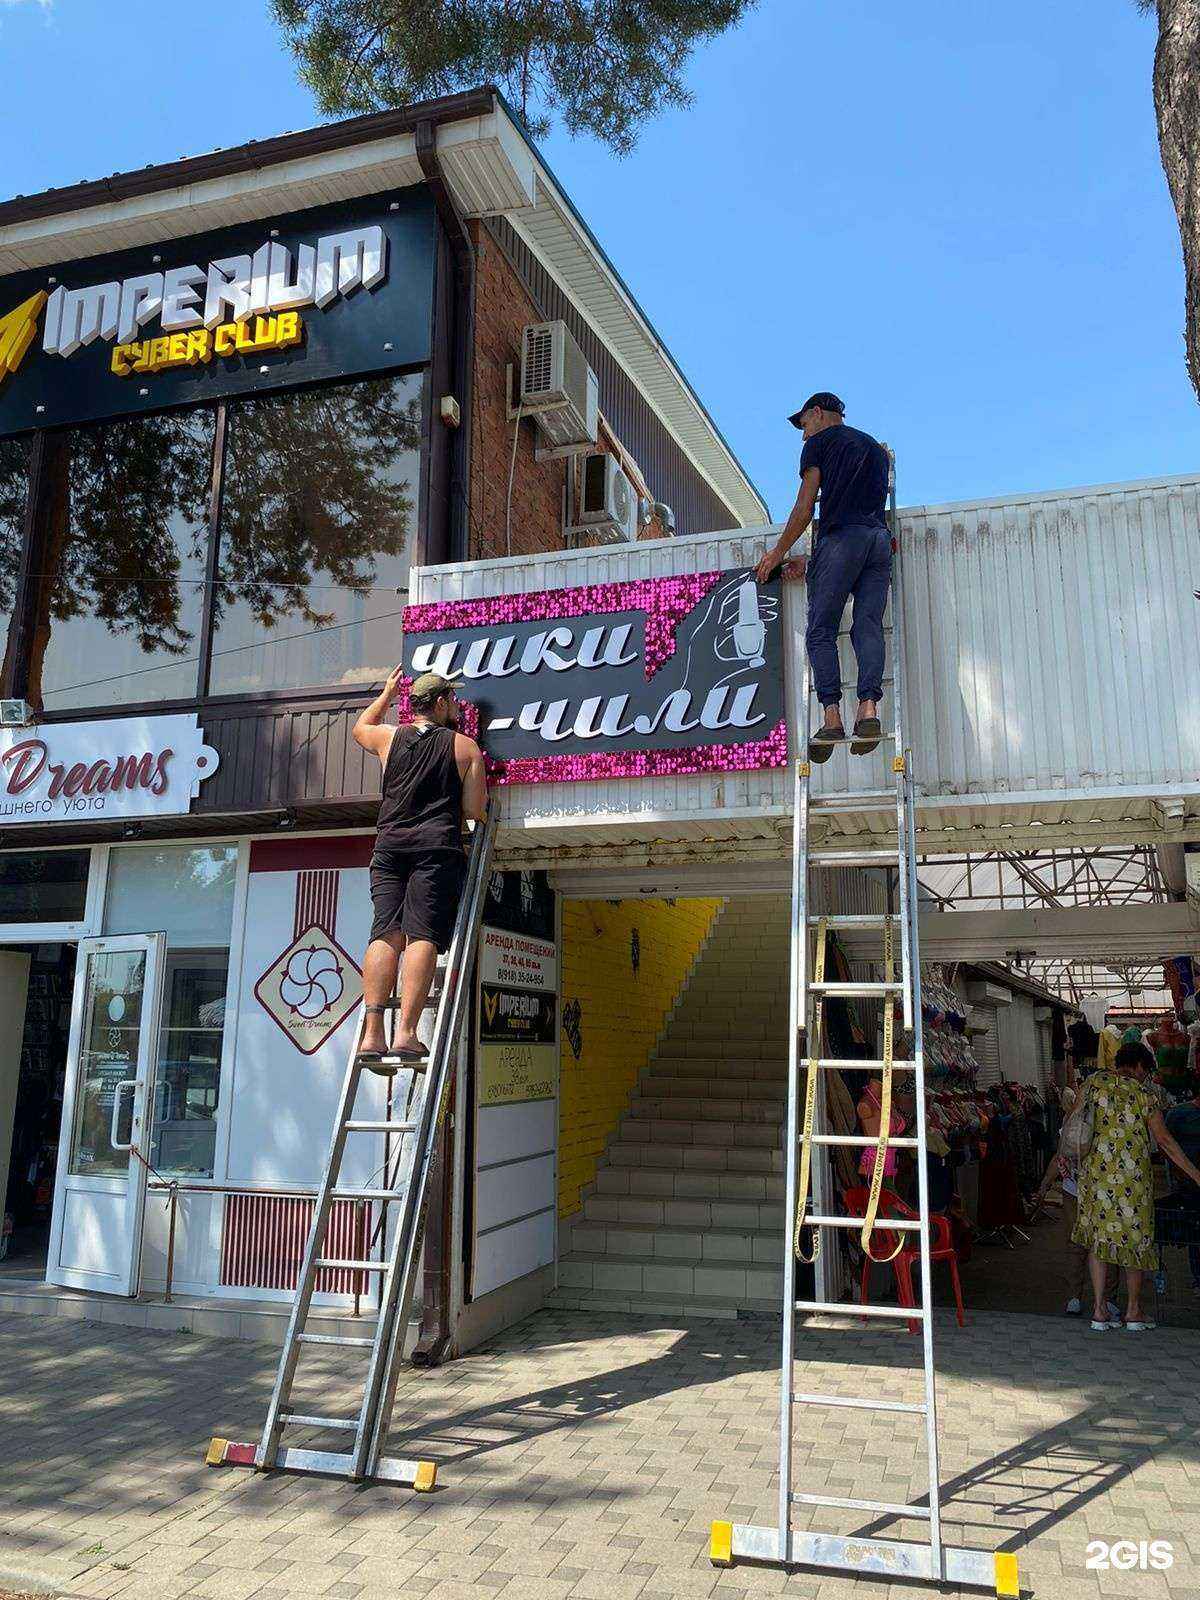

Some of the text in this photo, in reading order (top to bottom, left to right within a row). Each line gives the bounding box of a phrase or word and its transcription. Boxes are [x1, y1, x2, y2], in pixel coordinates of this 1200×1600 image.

[111, 312, 302, 376] CYBER CLUB
[411, 622, 638, 679] чики
[2, 739, 174, 799] Dreams
[63, 797, 105, 815] уюта
[485, 933, 515, 951] АРЕНДА
